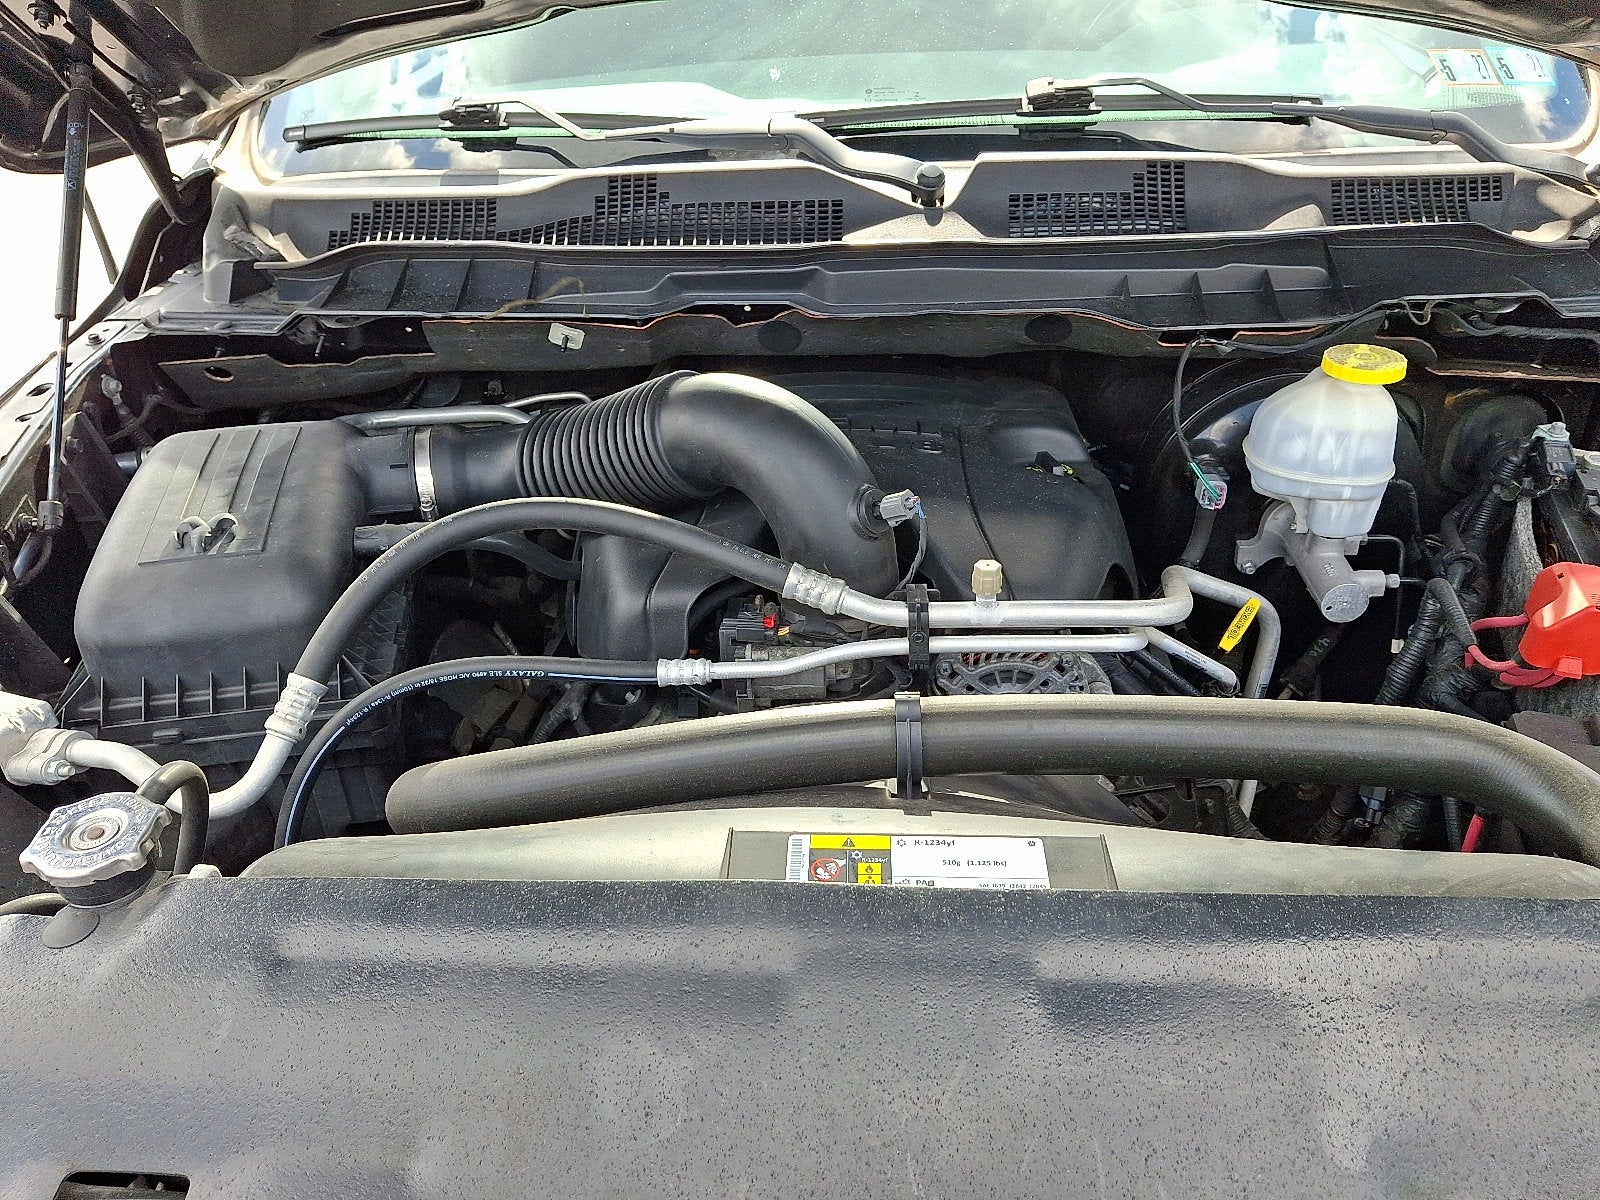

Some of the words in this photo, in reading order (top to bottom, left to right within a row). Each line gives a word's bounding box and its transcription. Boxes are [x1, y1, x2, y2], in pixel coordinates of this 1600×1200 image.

[1439, 58, 1456, 81] 5
[1496, 57, 1514, 79] 5
[439, 674, 458, 683] HOSE
[390, 684, 414, 697] (10mm)
[371, 694, 392, 707] R-134a
[914, 839, 956, 848] R-1234yf
[942, 859, 961, 868] 510g
[967, 859, 991, 867] (1.125
